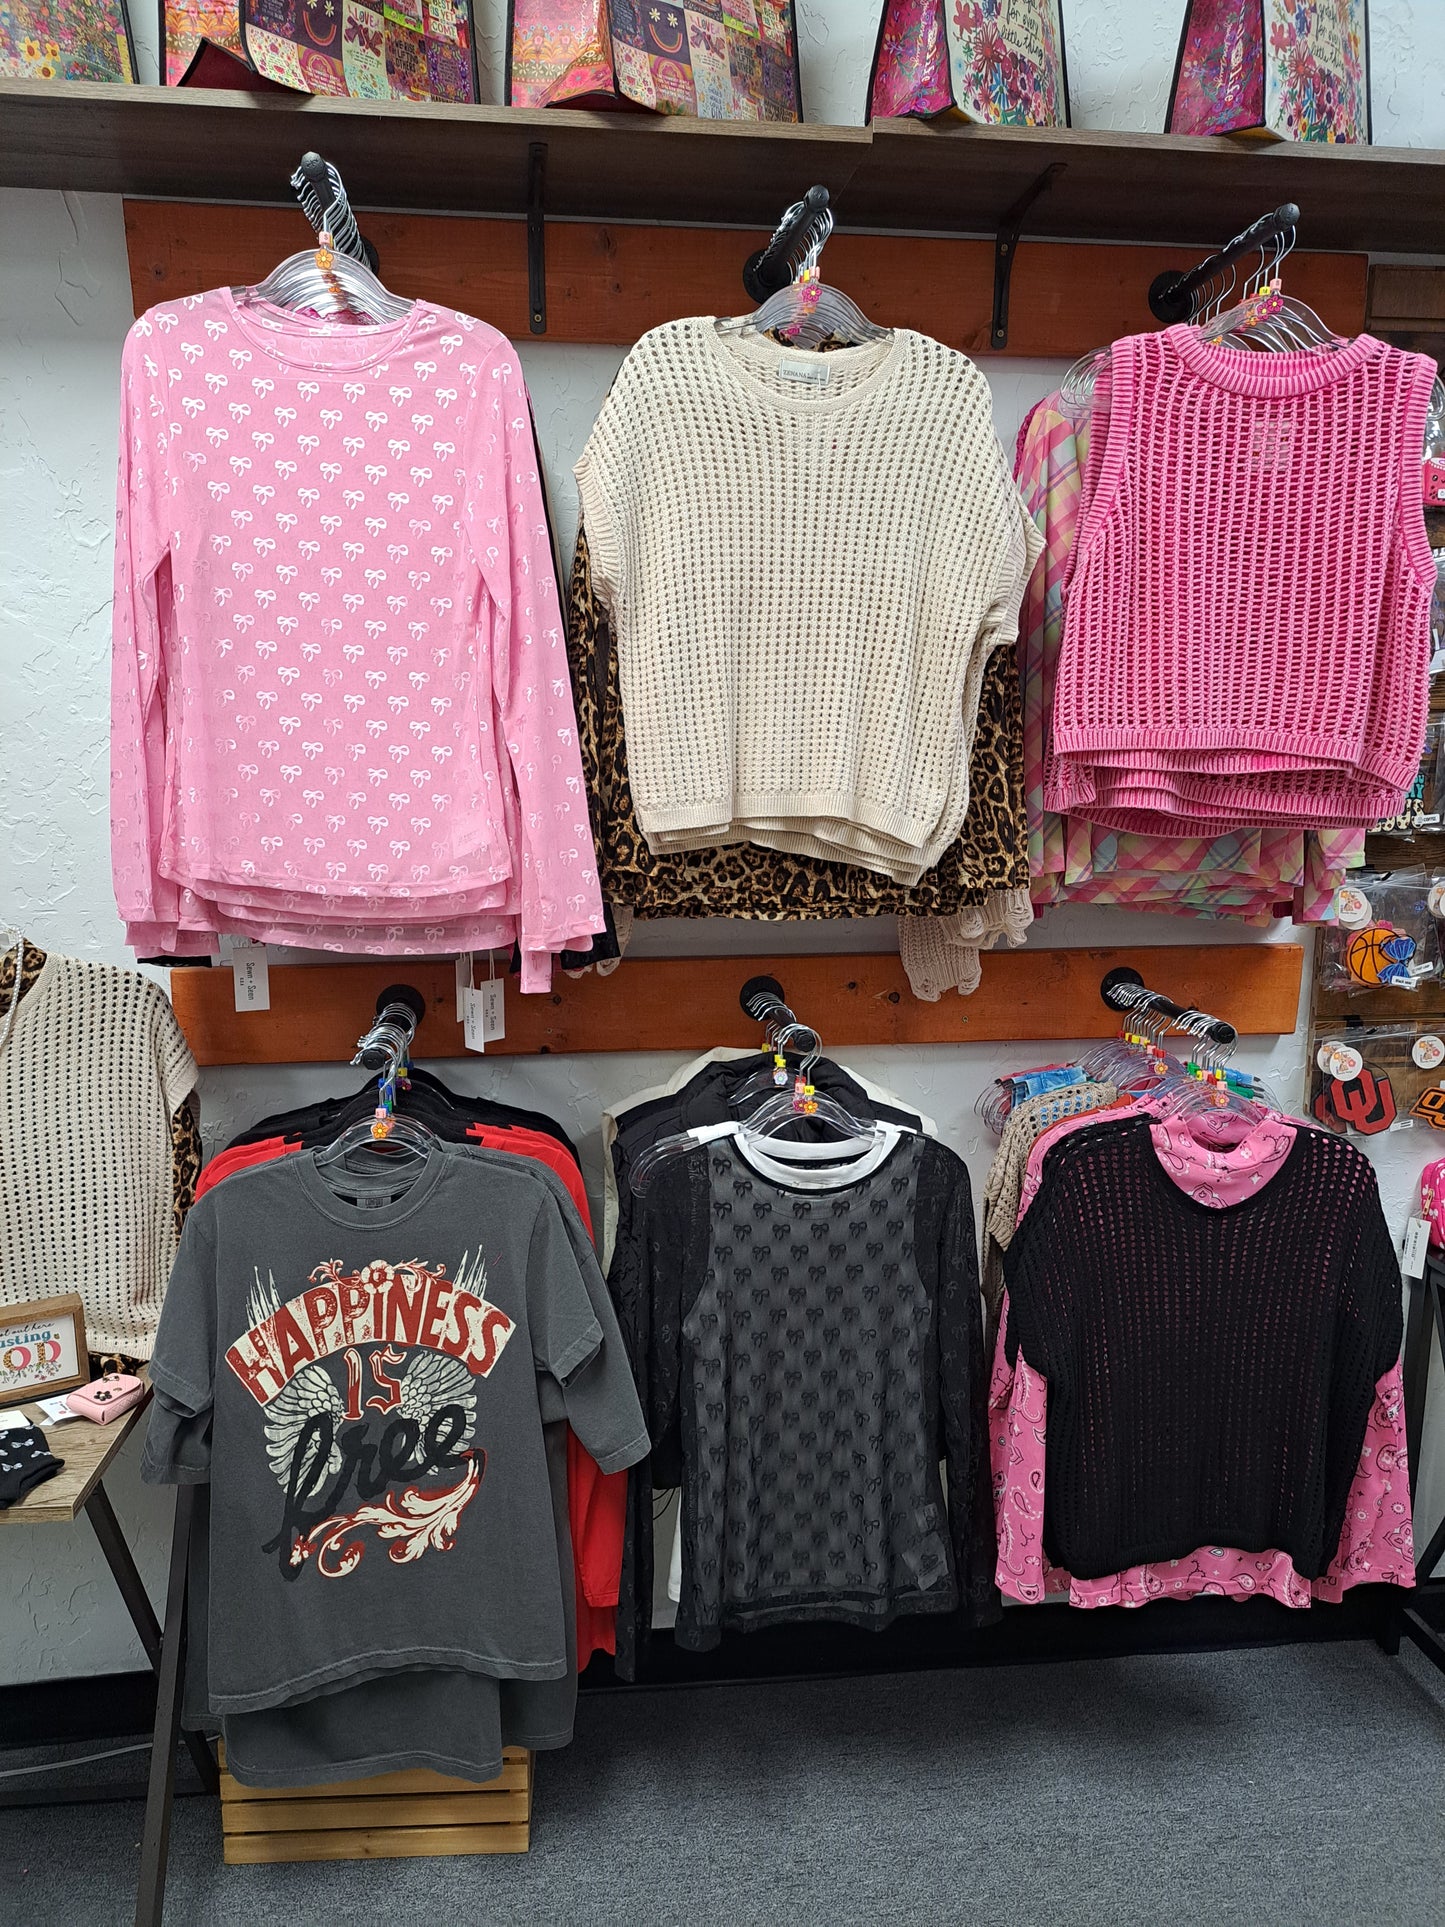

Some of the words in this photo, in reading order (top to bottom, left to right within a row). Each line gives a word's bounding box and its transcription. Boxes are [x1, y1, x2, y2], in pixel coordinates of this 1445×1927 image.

[0, 1331, 51, 1348] usting
[226, 1274, 511, 1401] HAPPINESS
[3, 1340, 62, 1371] OD
